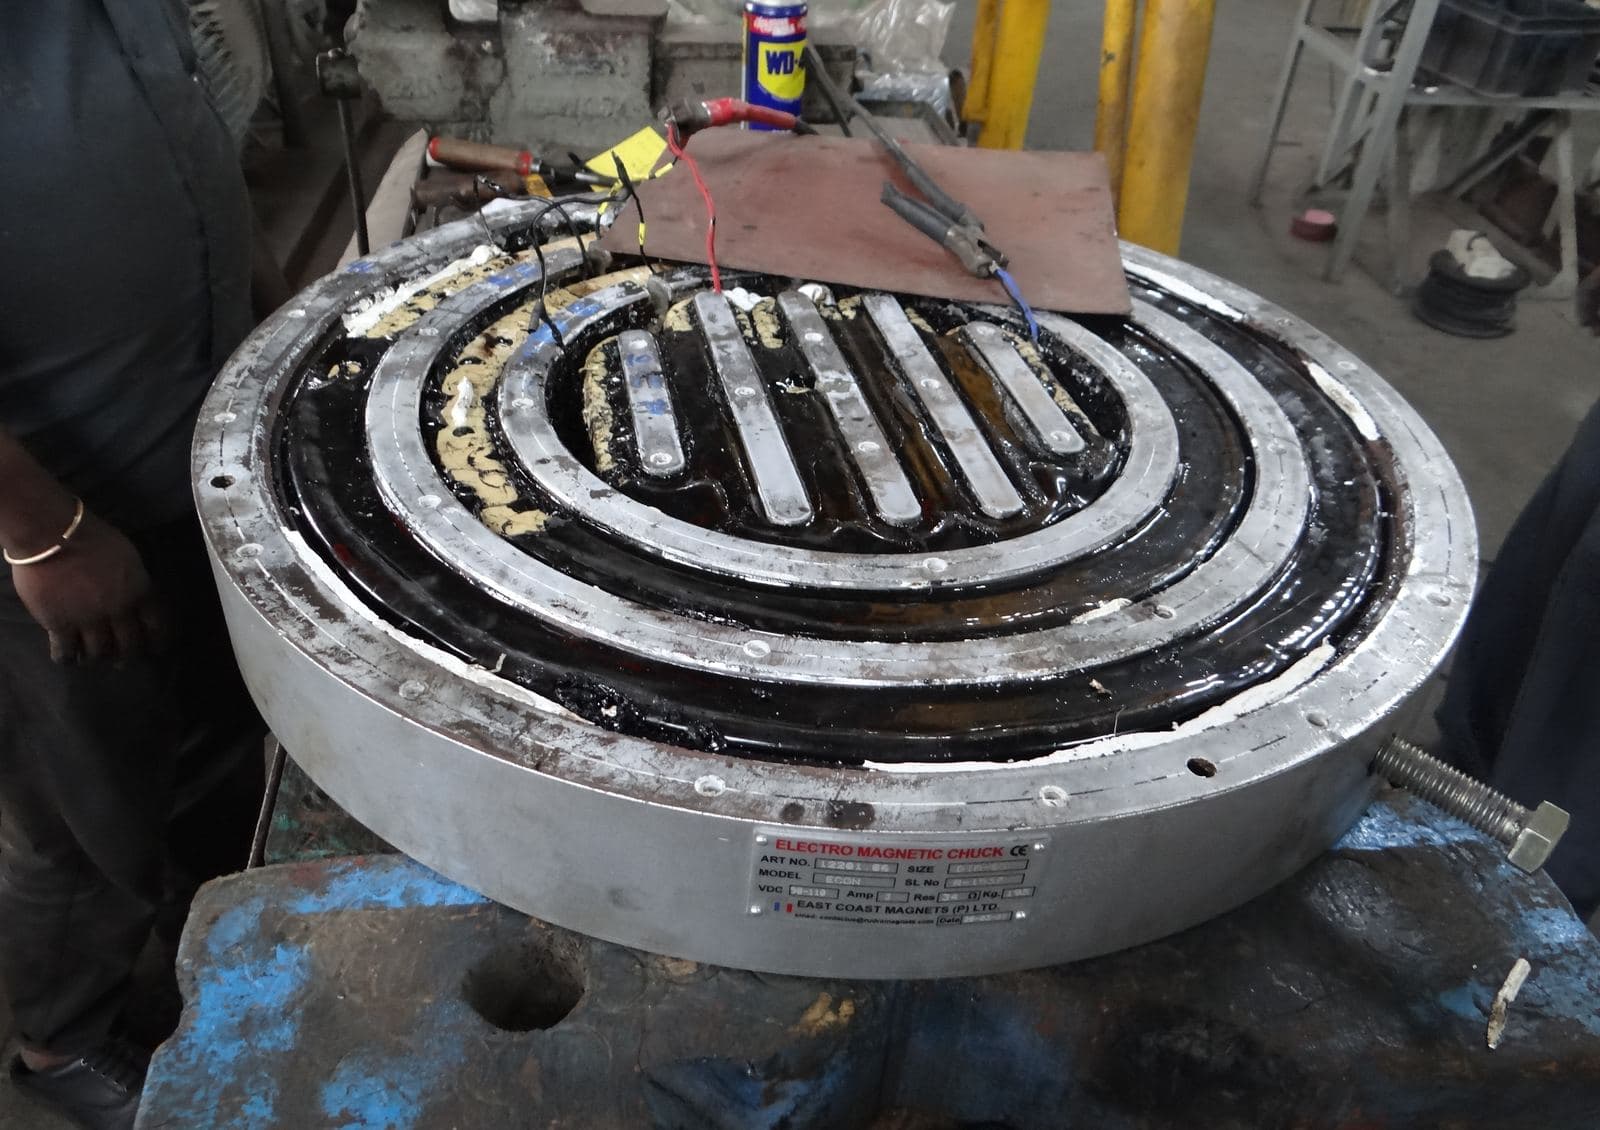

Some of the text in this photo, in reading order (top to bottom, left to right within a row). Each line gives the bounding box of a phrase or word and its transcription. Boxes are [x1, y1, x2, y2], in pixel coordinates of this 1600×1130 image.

[775, 838, 853, 856] ELECTRO
[857, 846, 943, 861] MAGNETIC
[946, 846, 1005, 860] CHUCK
[760, 855, 785, 865] ART
[789, 857, 811, 867] NO.
[758, 868, 802, 879] MODEL
[906, 865, 935, 873] SIZE
[904, 878, 920, 887] SL
[923, 879, 940, 887] No
[758, 884, 783, 894] VDC
[846, 890, 874, 900] Amp
[913, 893, 935, 901] Res
[796, 899, 833, 910] EAST
[835, 901, 881, 913] COAST
[884, 905, 949, 915] MAGNETS
[952, 904, 970, 913] (P)
